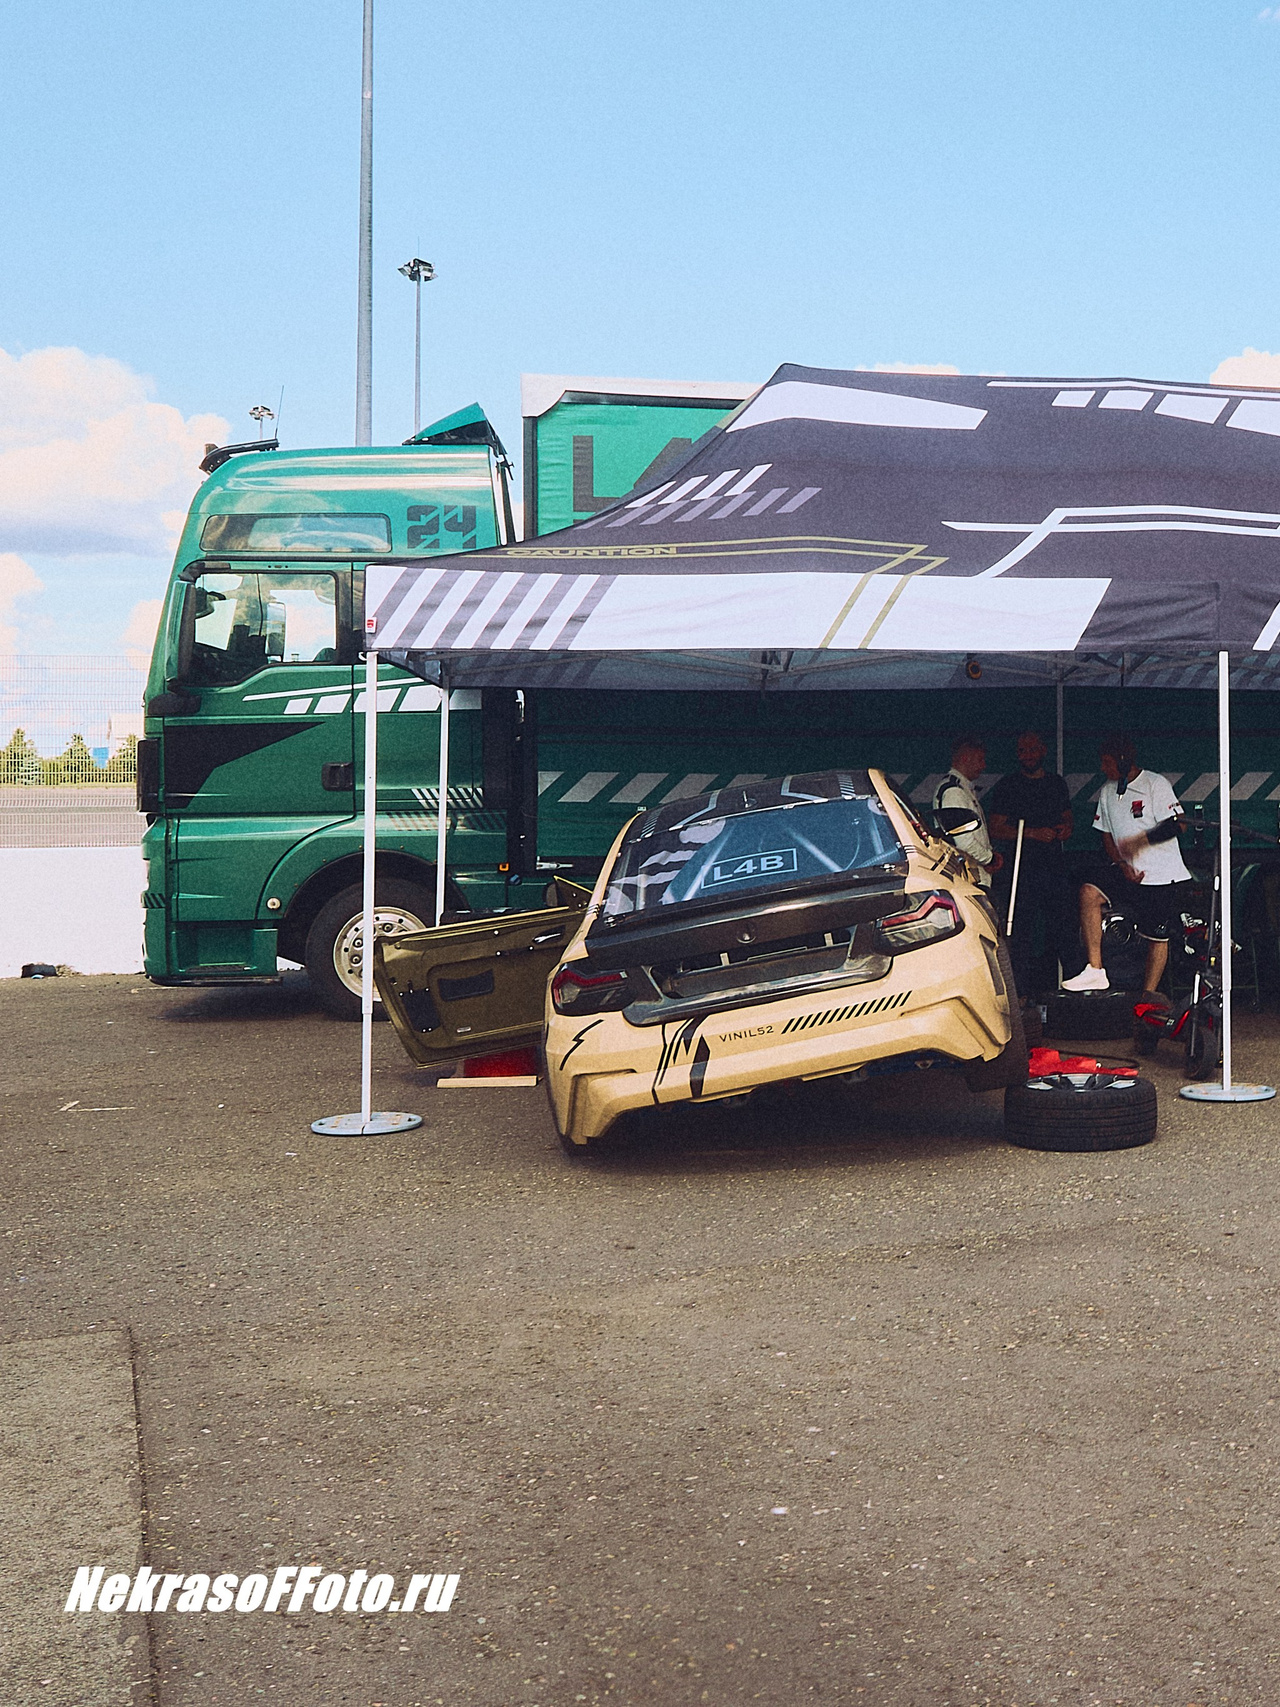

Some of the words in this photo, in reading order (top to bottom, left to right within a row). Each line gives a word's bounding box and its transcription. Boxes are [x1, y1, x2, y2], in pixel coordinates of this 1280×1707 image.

[406, 504, 477, 549] 24
[506, 547, 677, 556] CAUNTION
[713, 855, 785, 881] L4B
[719, 1025, 774, 1042] VINIL52
